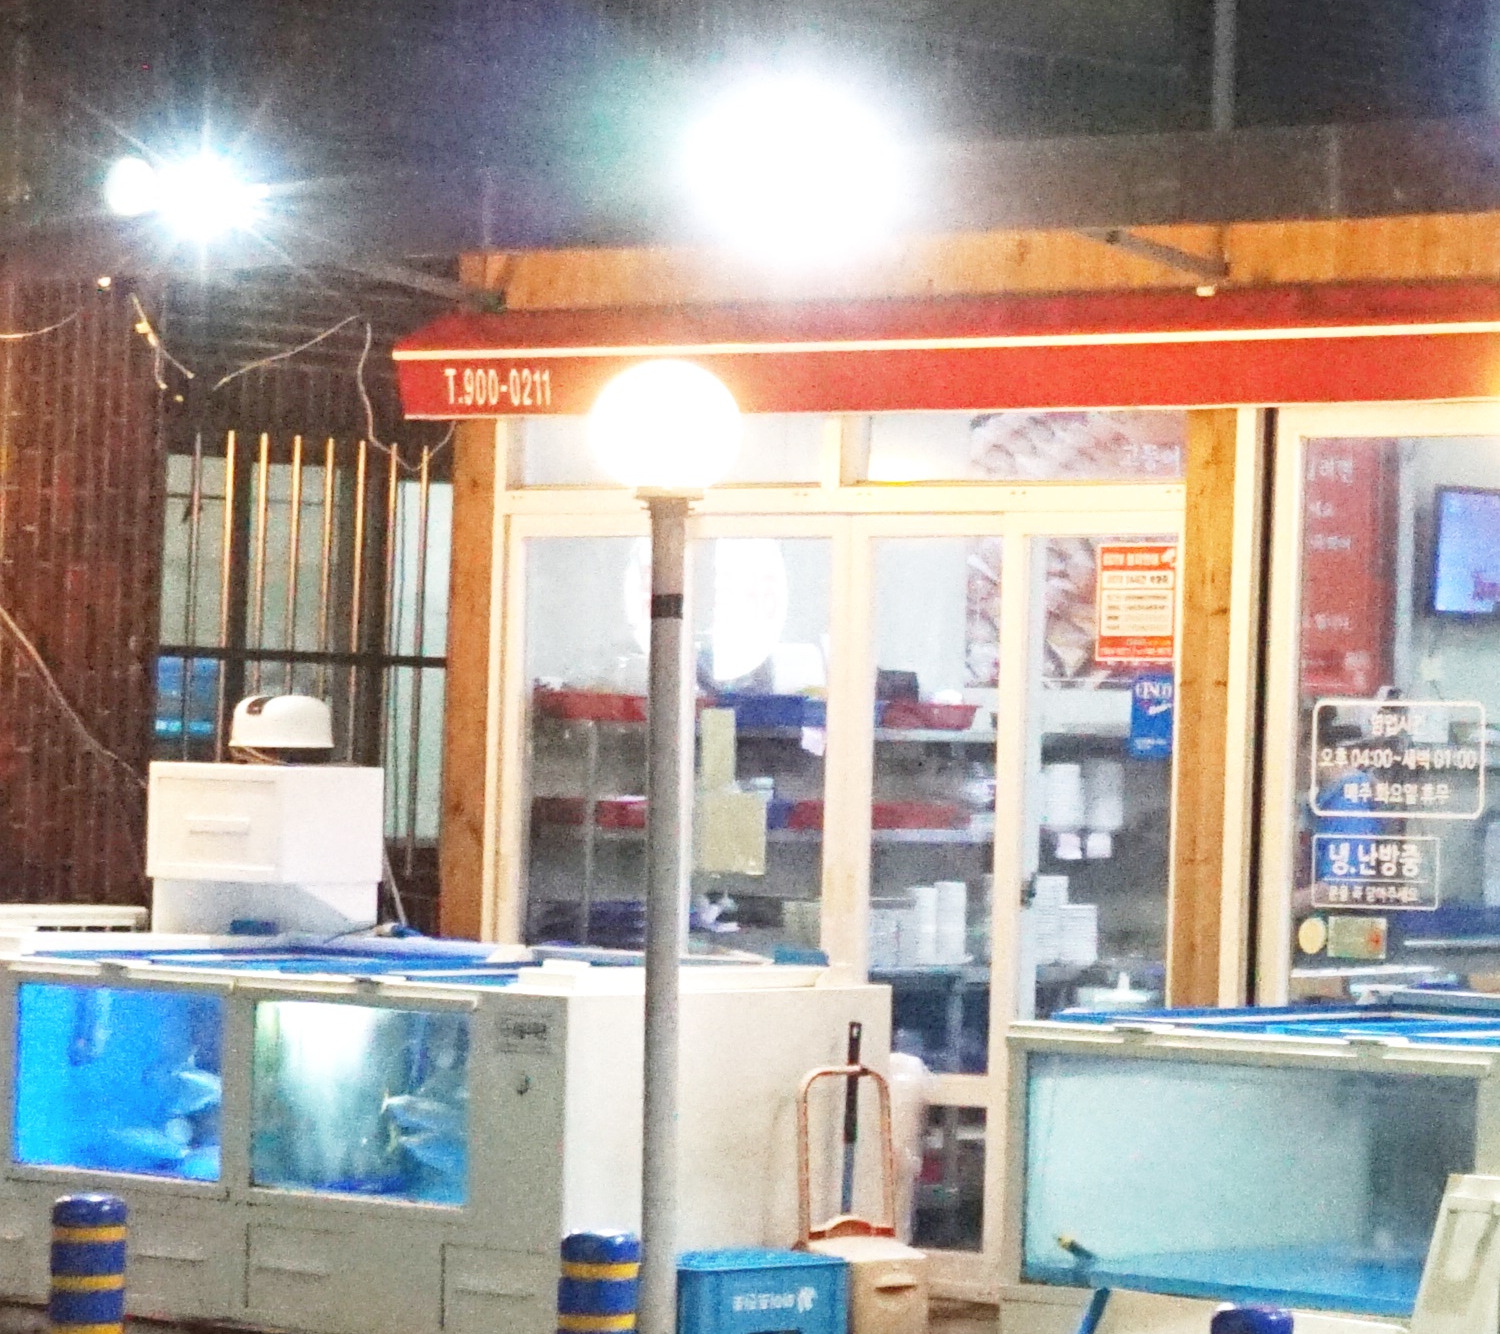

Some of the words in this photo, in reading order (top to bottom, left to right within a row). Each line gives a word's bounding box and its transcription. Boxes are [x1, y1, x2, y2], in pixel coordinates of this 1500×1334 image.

[444, 368, 552, 407] T.900-0211
[1318, 748, 1348, 768] 오후
[1433, 749, 1478, 769] 01:00
[1343, 782, 1373, 803] 매주
[1376, 782, 1418, 804] 화요일
